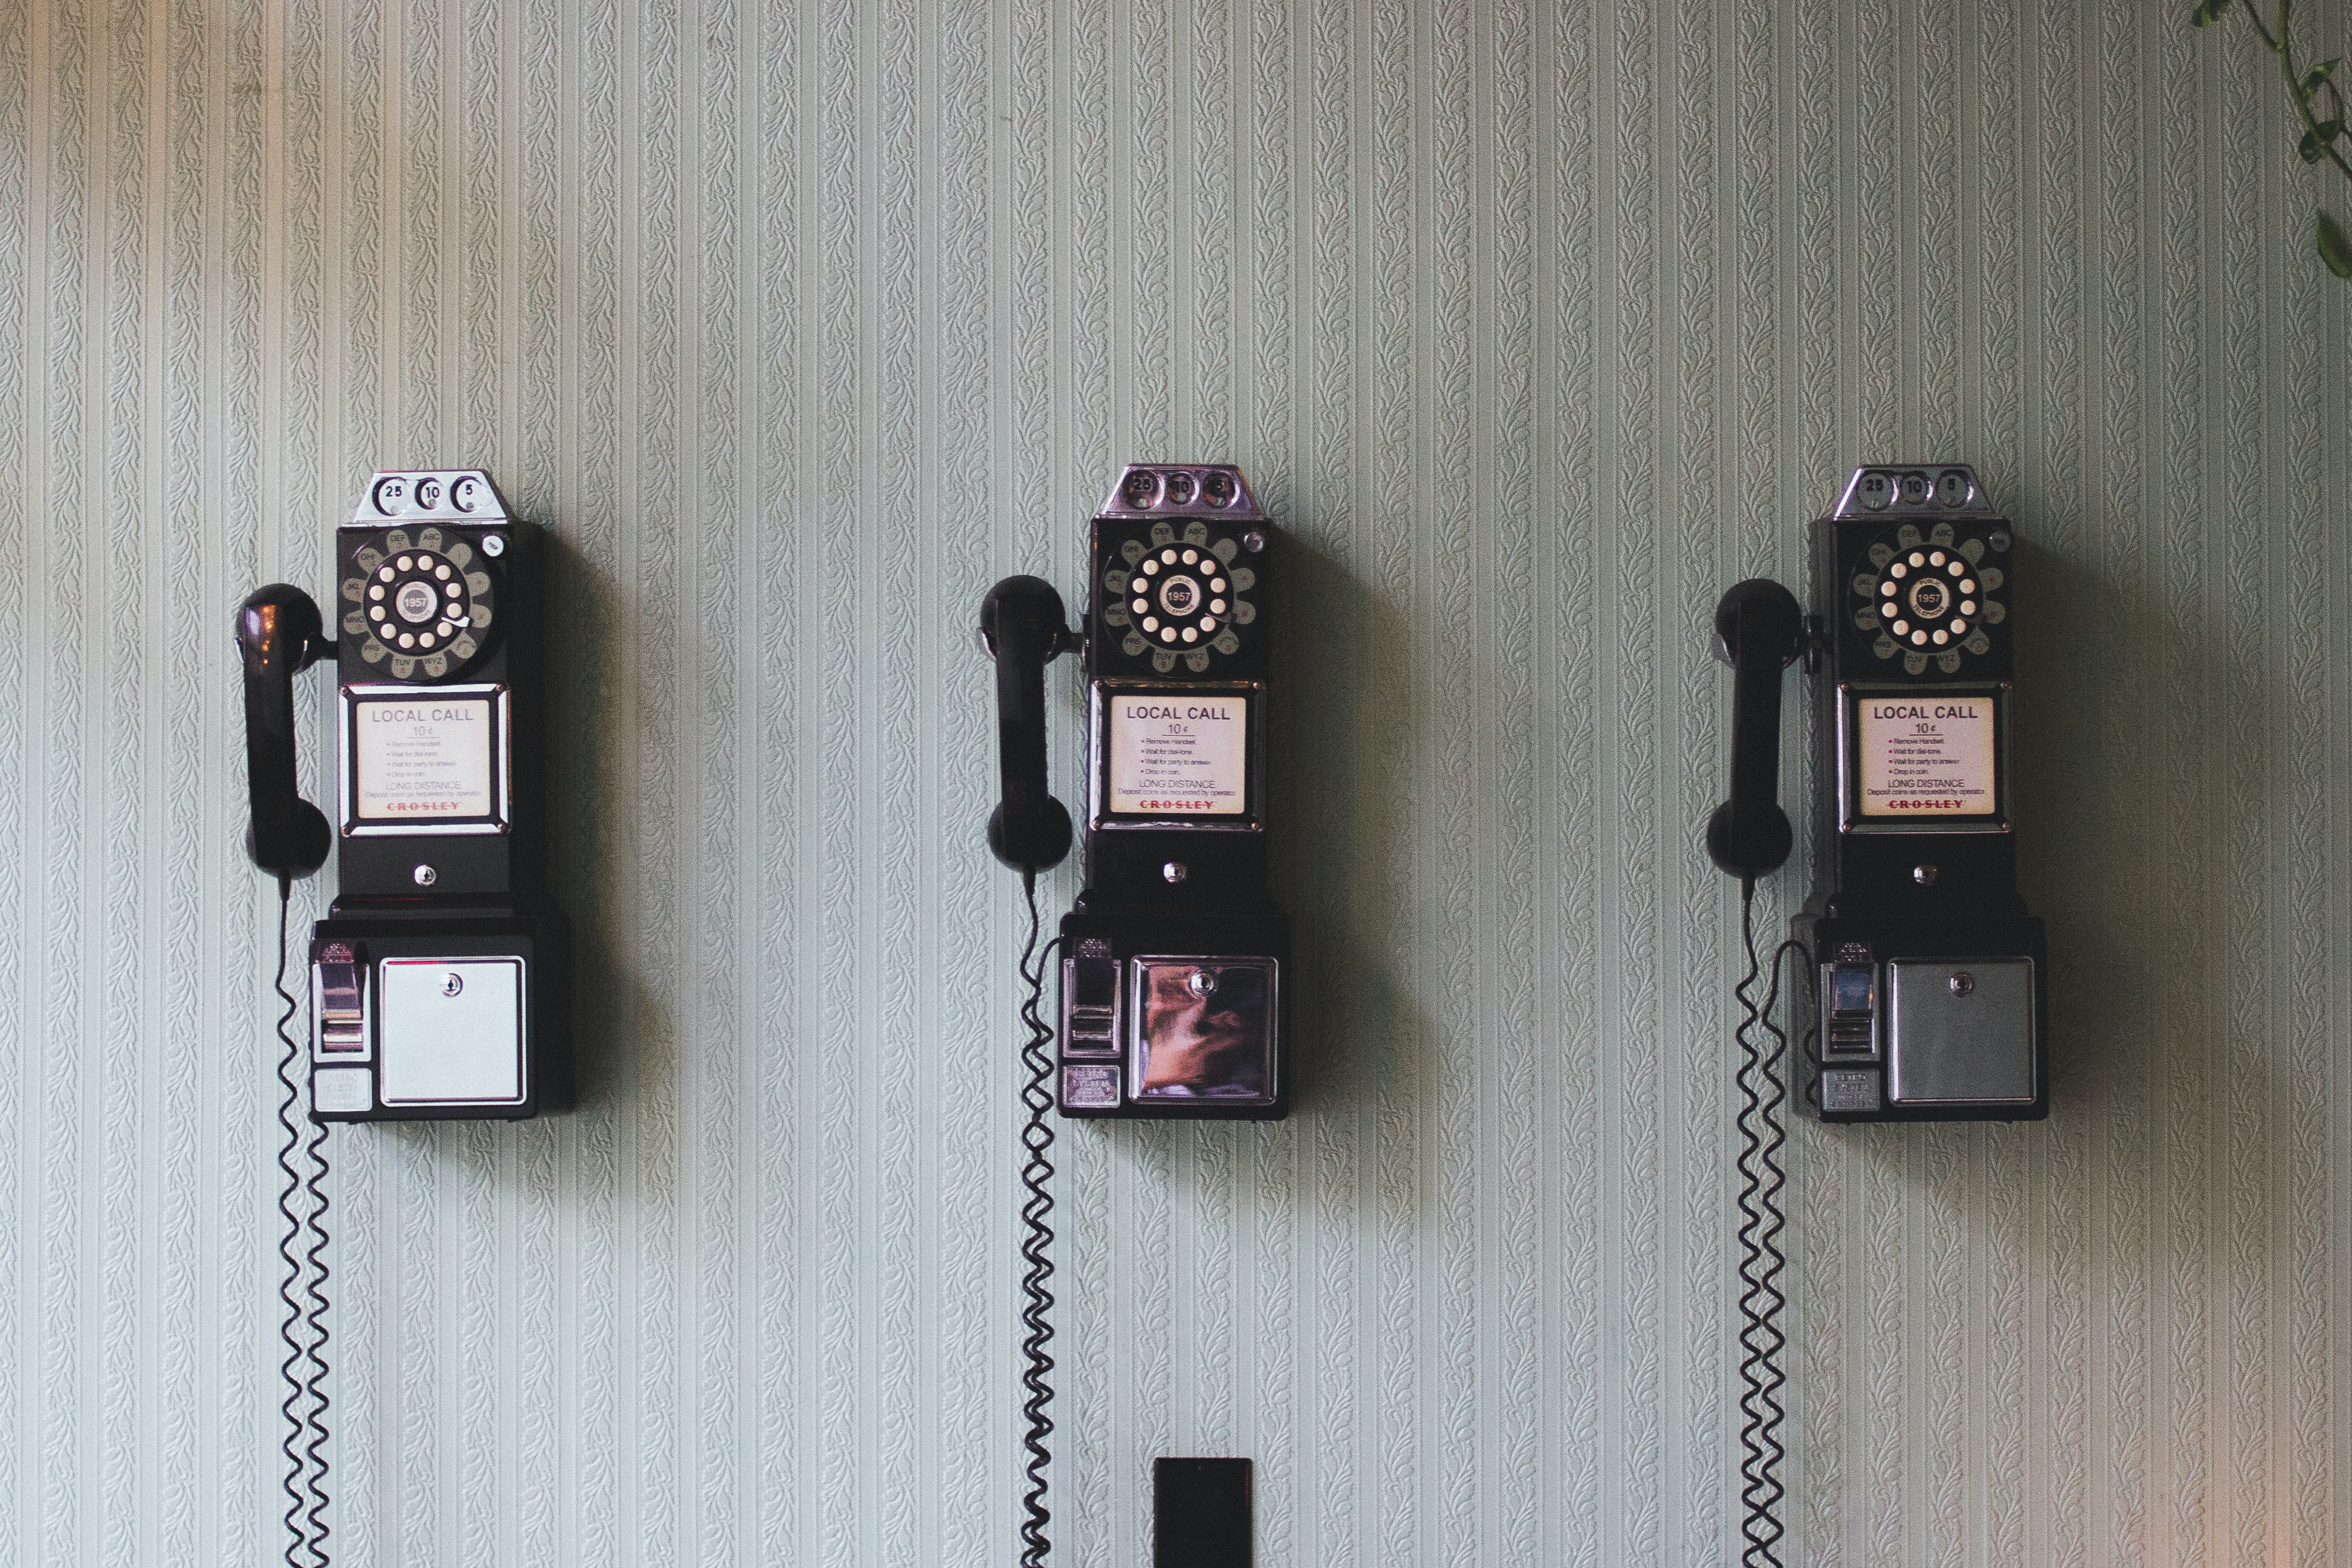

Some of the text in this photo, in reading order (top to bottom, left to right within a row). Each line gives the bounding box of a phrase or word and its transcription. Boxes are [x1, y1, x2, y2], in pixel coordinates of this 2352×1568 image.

[1134, 478, 1151, 491] 25
[1866, 478, 1955, 493] 25 10 5
[386, 484, 473, 498] 25 10 5
[1167, 592, 1191, 601] 1957
[1918, 594, 1941, 603] 1957
[405, 598, 427, 607] 1957
[1913, 604, 1945, 616] TELEPHONE
[372, 709, 475, 722] LOCAL CALL
[1127, 707, 1230, 720] LOCAL CALL
[1874, 706, 1978, 719] LOCAL CALL
[414, 726, 425, 736] 10
[1168, 724, 1181, 734] 10
[1915, 723, 1929, 734] 10
[386, 781, 461, 791] LONG DISTANCE
[1139, 780, 1216, 788] LONG DISTANCE
[1888, 779, 1965, 788] LONG DISTANCE
[386, 802, 461, 811] CROSLEY
[1139, 800, 1214, 809] CROSLEY
[1888, 800, 1963, 809] CROSLEY
